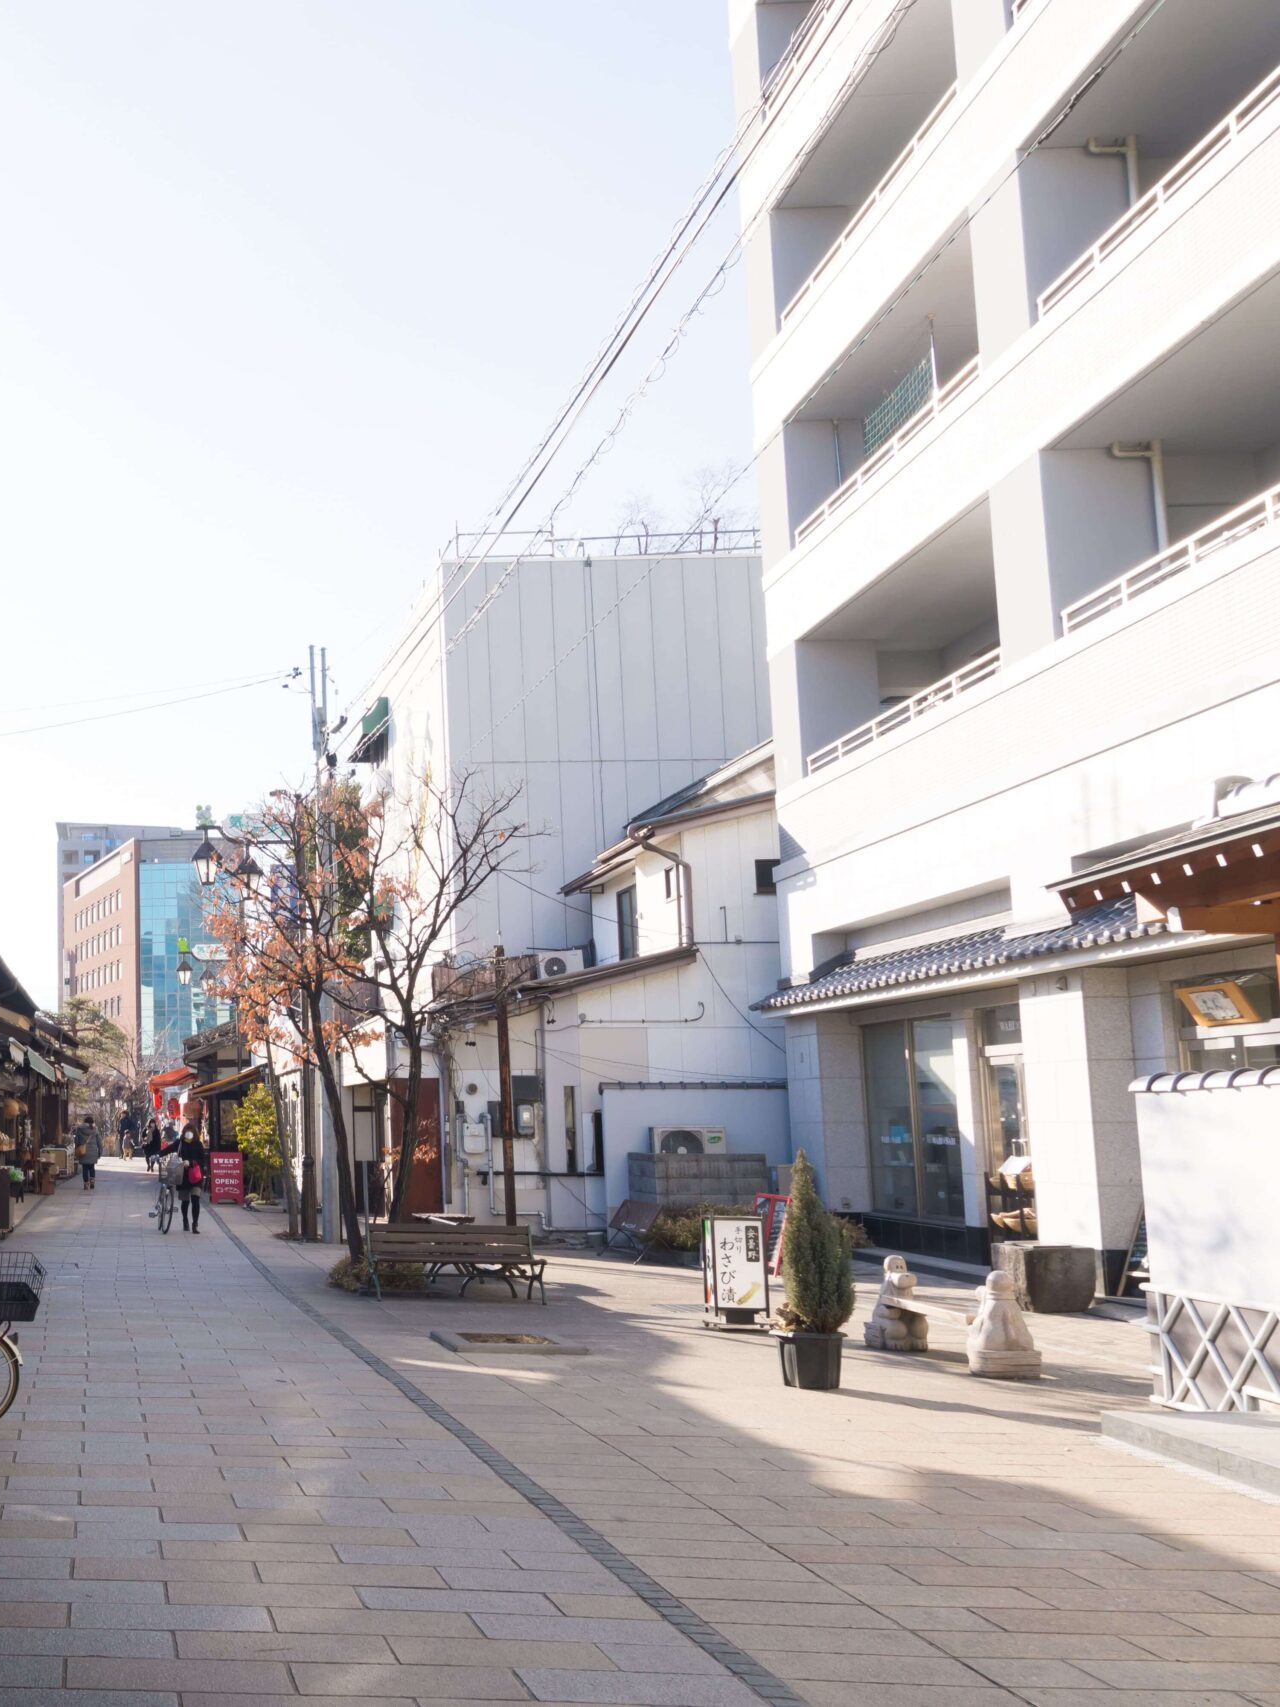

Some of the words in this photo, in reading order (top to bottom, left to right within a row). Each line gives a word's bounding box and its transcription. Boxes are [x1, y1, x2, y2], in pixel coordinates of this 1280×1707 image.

[746, 1227, 759, 1260] 安曇野
[720, 1236, 737, 1304] わさび漬
